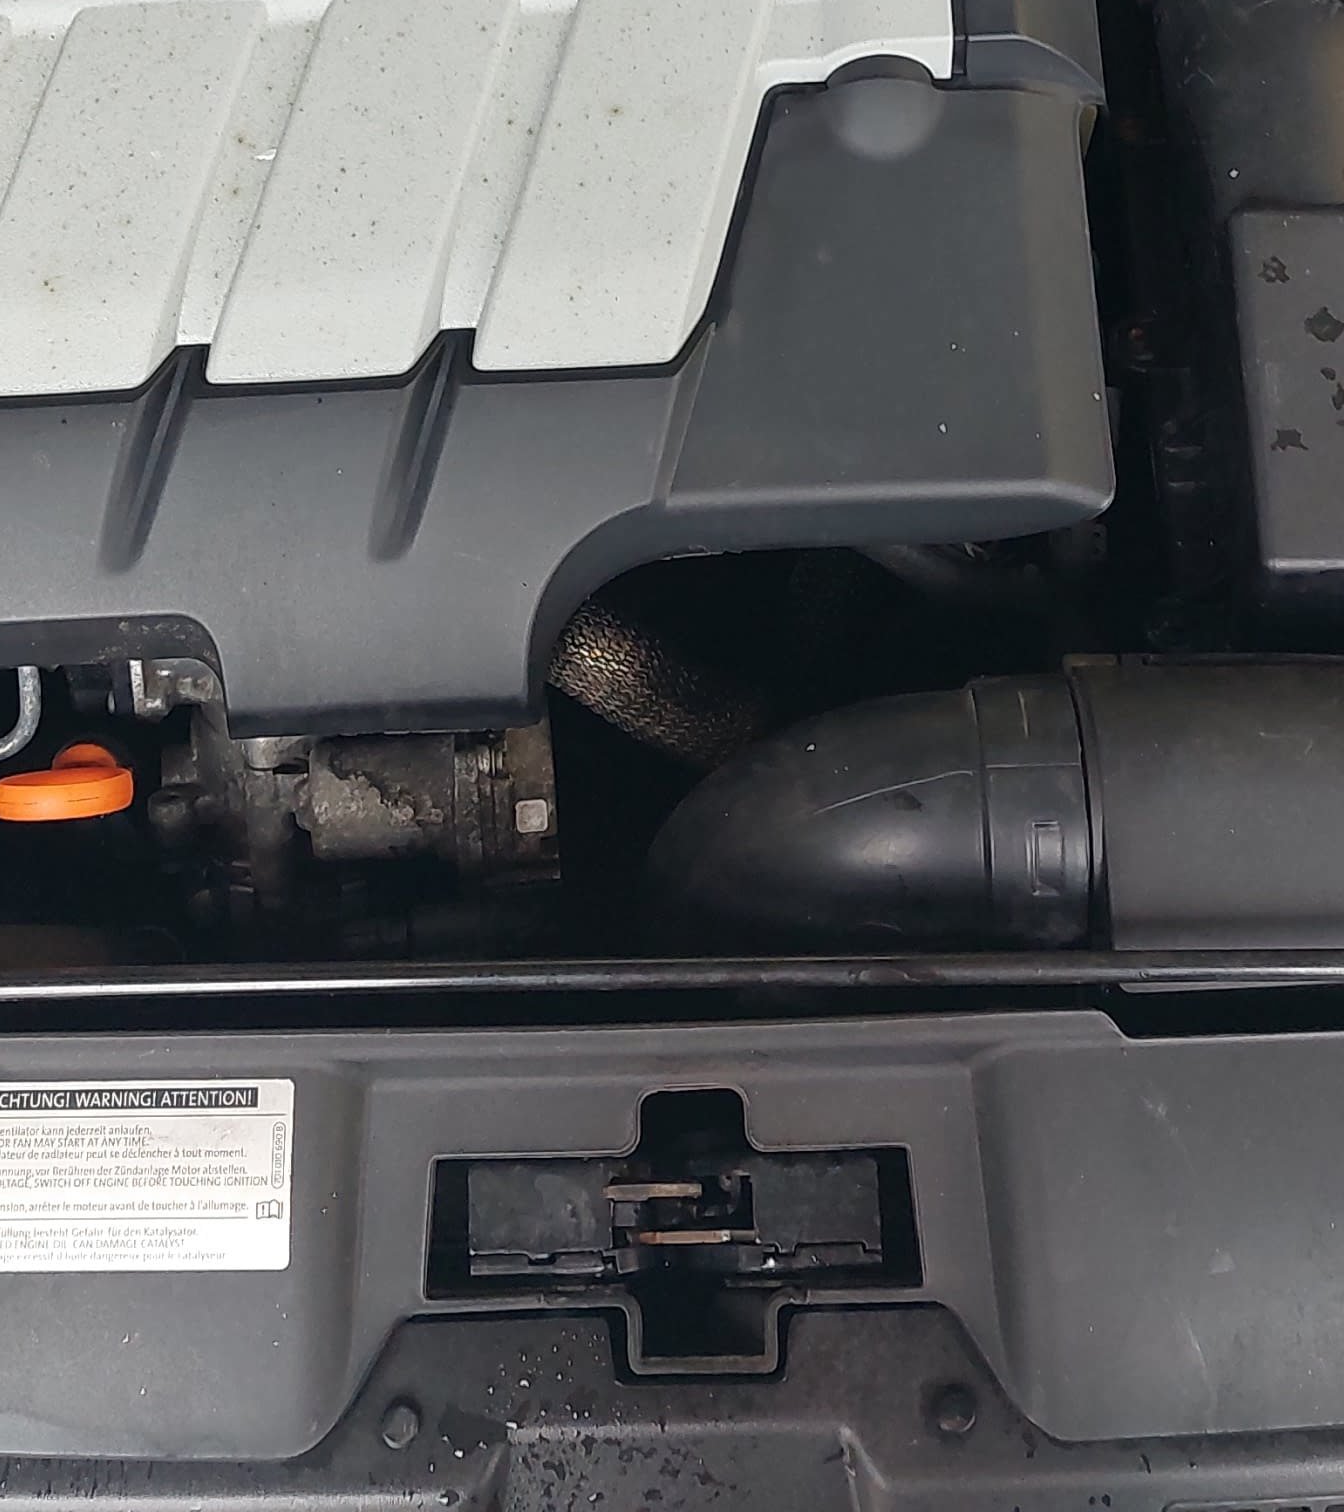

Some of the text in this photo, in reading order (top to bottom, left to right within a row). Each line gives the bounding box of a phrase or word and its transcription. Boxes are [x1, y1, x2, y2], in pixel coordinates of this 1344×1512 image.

[74, 1090, 157, 1108] WARNING!
[160, 1089, 254, 1107] ATTENTION!
[42, 1126, 64, 1136] kann
[13, 1138, 32, 1148] FAN
[34, 1138, 55, 1148] MAY
[58, 1138, 85, 1147] START
[87, 1138, 99, 1147] AT
[102, 1138, 122, 1147] ANY
[28, 1150, 39, 1160] de
[41, 1149, 84, 1160] radiateur
[86, 1149, 106, 1162] peut
[110, 1151, 120, 1159] se
[182, 1148, 202, 1158] tout
[36, 1168, 50, 1176] vor
[96, 1165, 112, 1176] der
[171, 1165, 200, 1175] Motor
[34, 1177, 71, 1188] SWITCH
[73, 1177, 91, 1188] OFF
[93, 1177, 129, 1188] ENGINE
[132, 1176, 168, 1187] BEFORE
[170, 1176, 221, 1187] TOUCHING
[224, 1175, 268, 1187] IGNITION
[62, 1201, 70, 1212] le
[72, 1201, 107, 1212] moteur
[109, 1200, 135, 1211] avant
[138, 1200, 150, 1211] de
[151, 1200, 188, 1211] toucher
